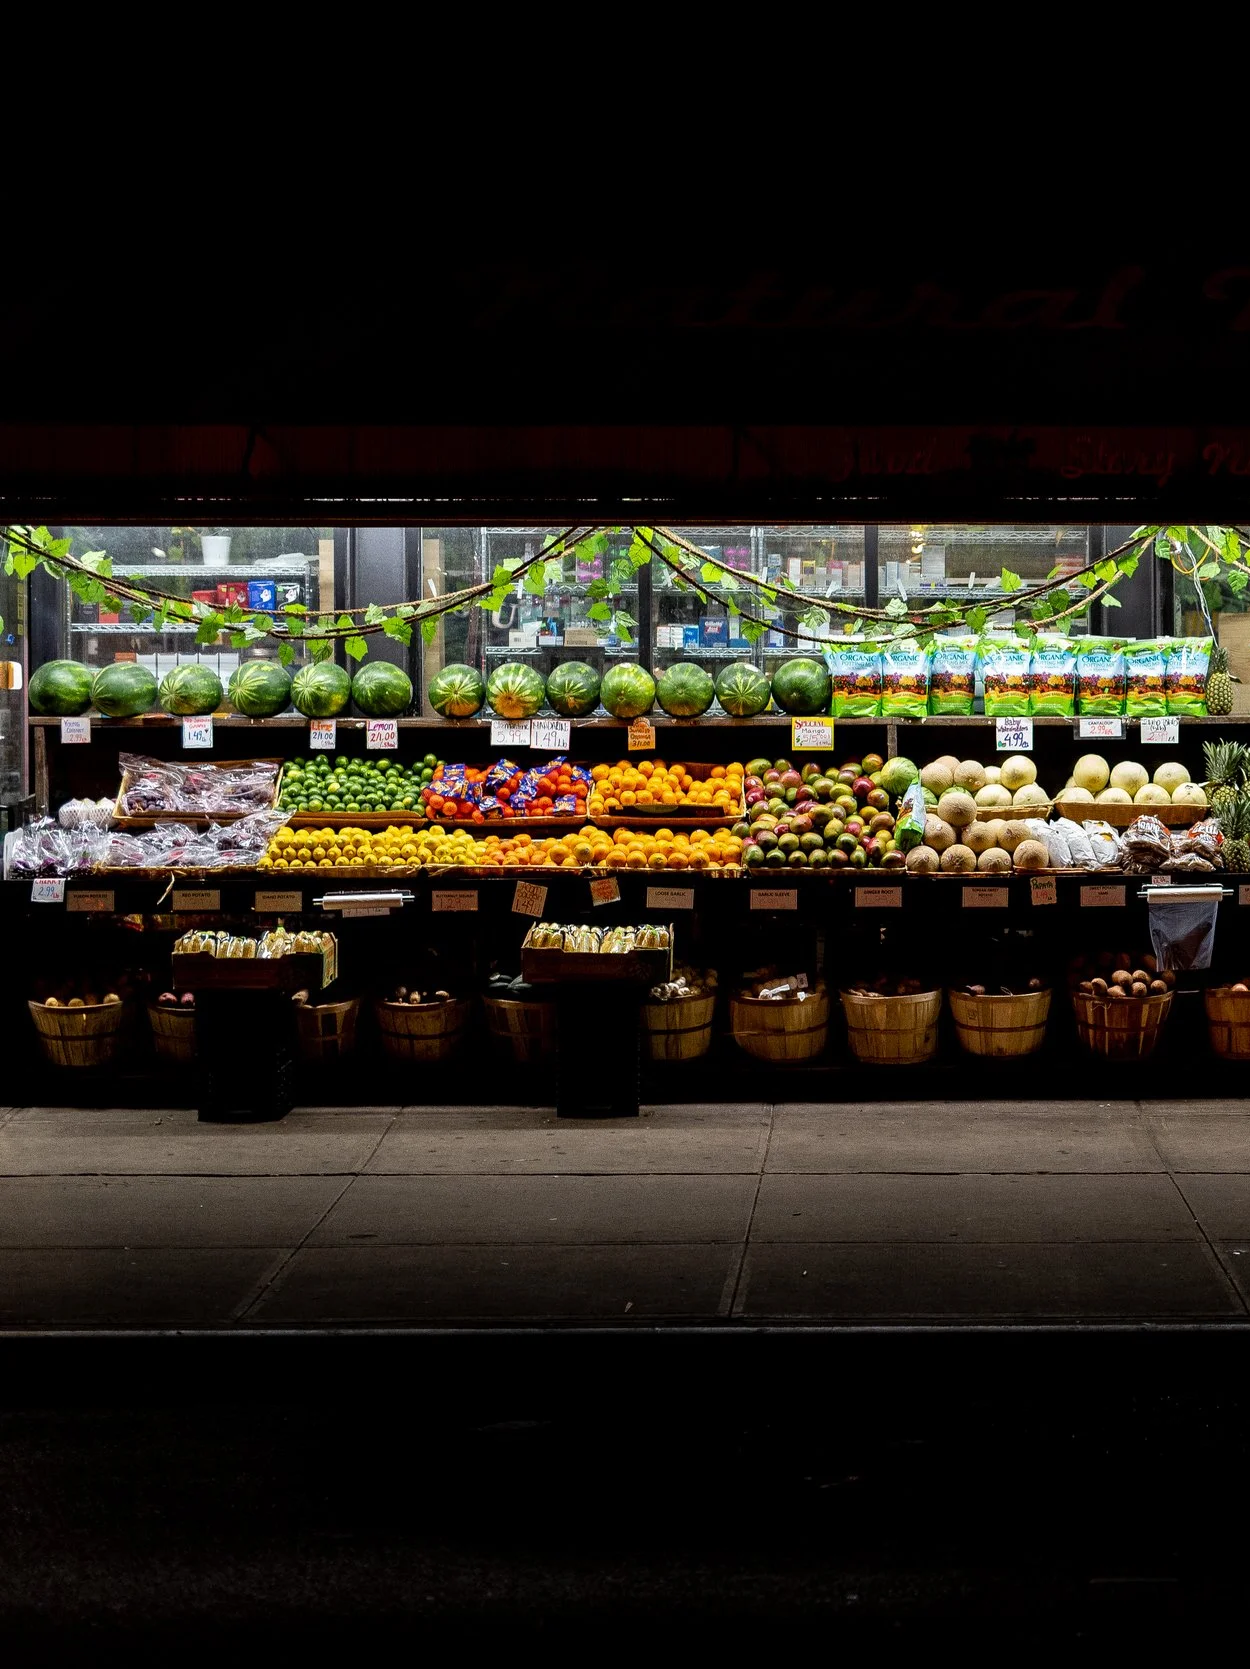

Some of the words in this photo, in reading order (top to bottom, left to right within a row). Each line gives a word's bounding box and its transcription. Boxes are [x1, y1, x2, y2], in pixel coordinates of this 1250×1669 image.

[840, 654, 877, 662] ORGANIC
[935, 653, 970, 661] ORGANIC
[367, 720, 394, 732] Lemon
[1004, 717, 1021, 728] Baby
[312, 731, 334, 741] 2/1.00
[801, 728, 826, 736] Mango
[371, 732, 395, 743] 2/1.00
